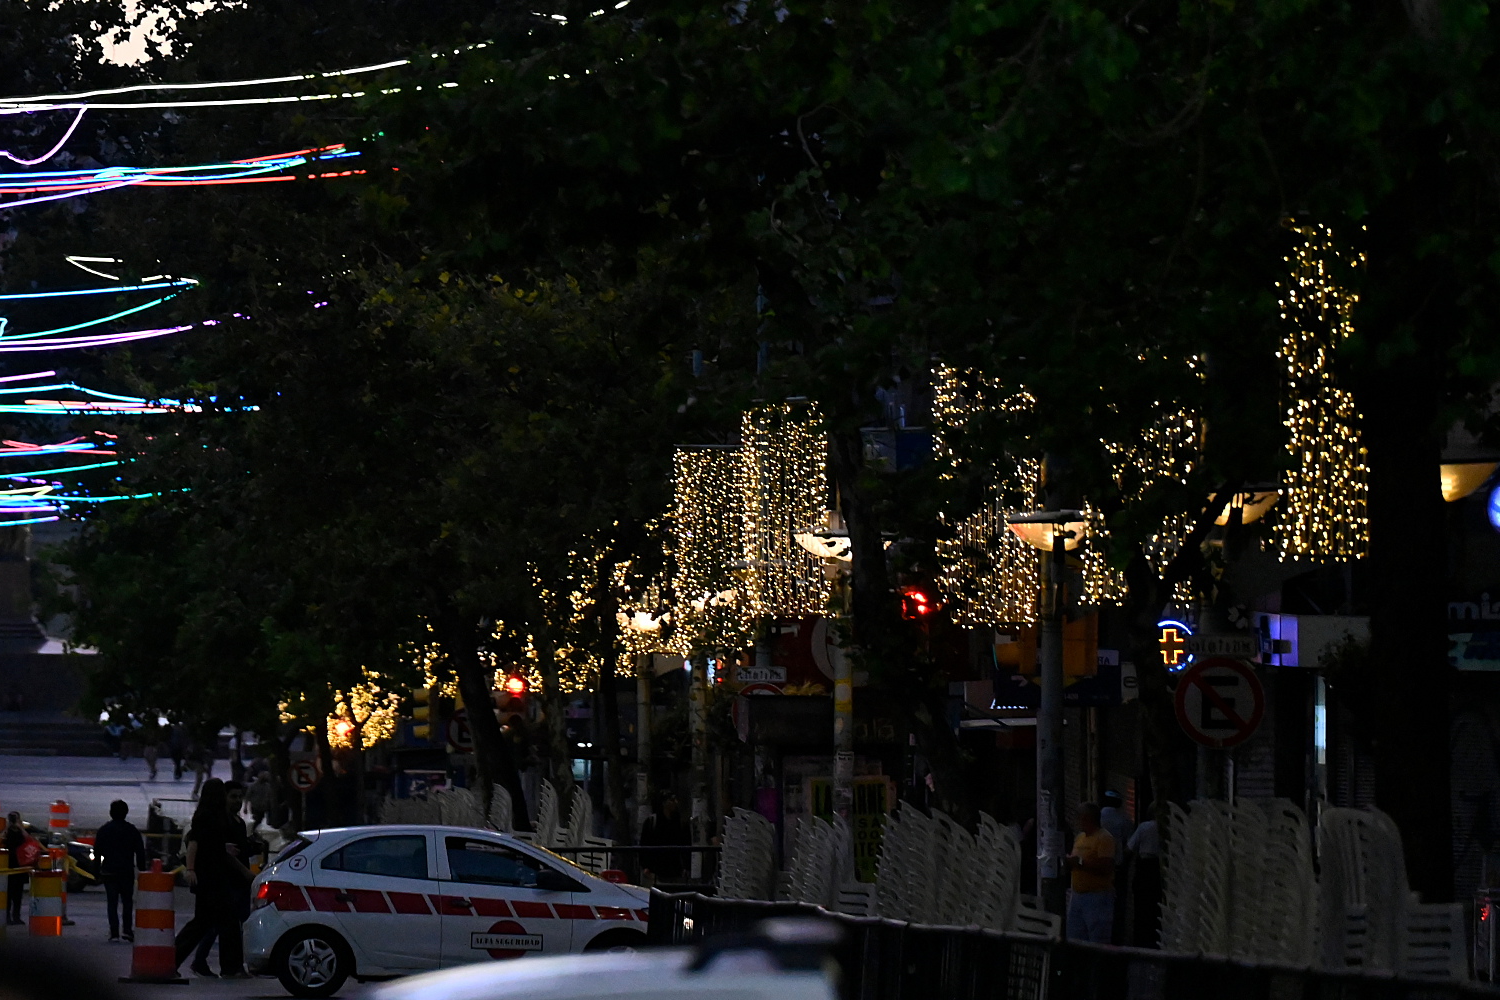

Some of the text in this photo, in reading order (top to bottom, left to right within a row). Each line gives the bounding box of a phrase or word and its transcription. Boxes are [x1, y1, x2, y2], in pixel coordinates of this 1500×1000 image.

[293, 858, 302, 867] 7
[475, 937, 540, 946] ALTA SEGURIDAD
